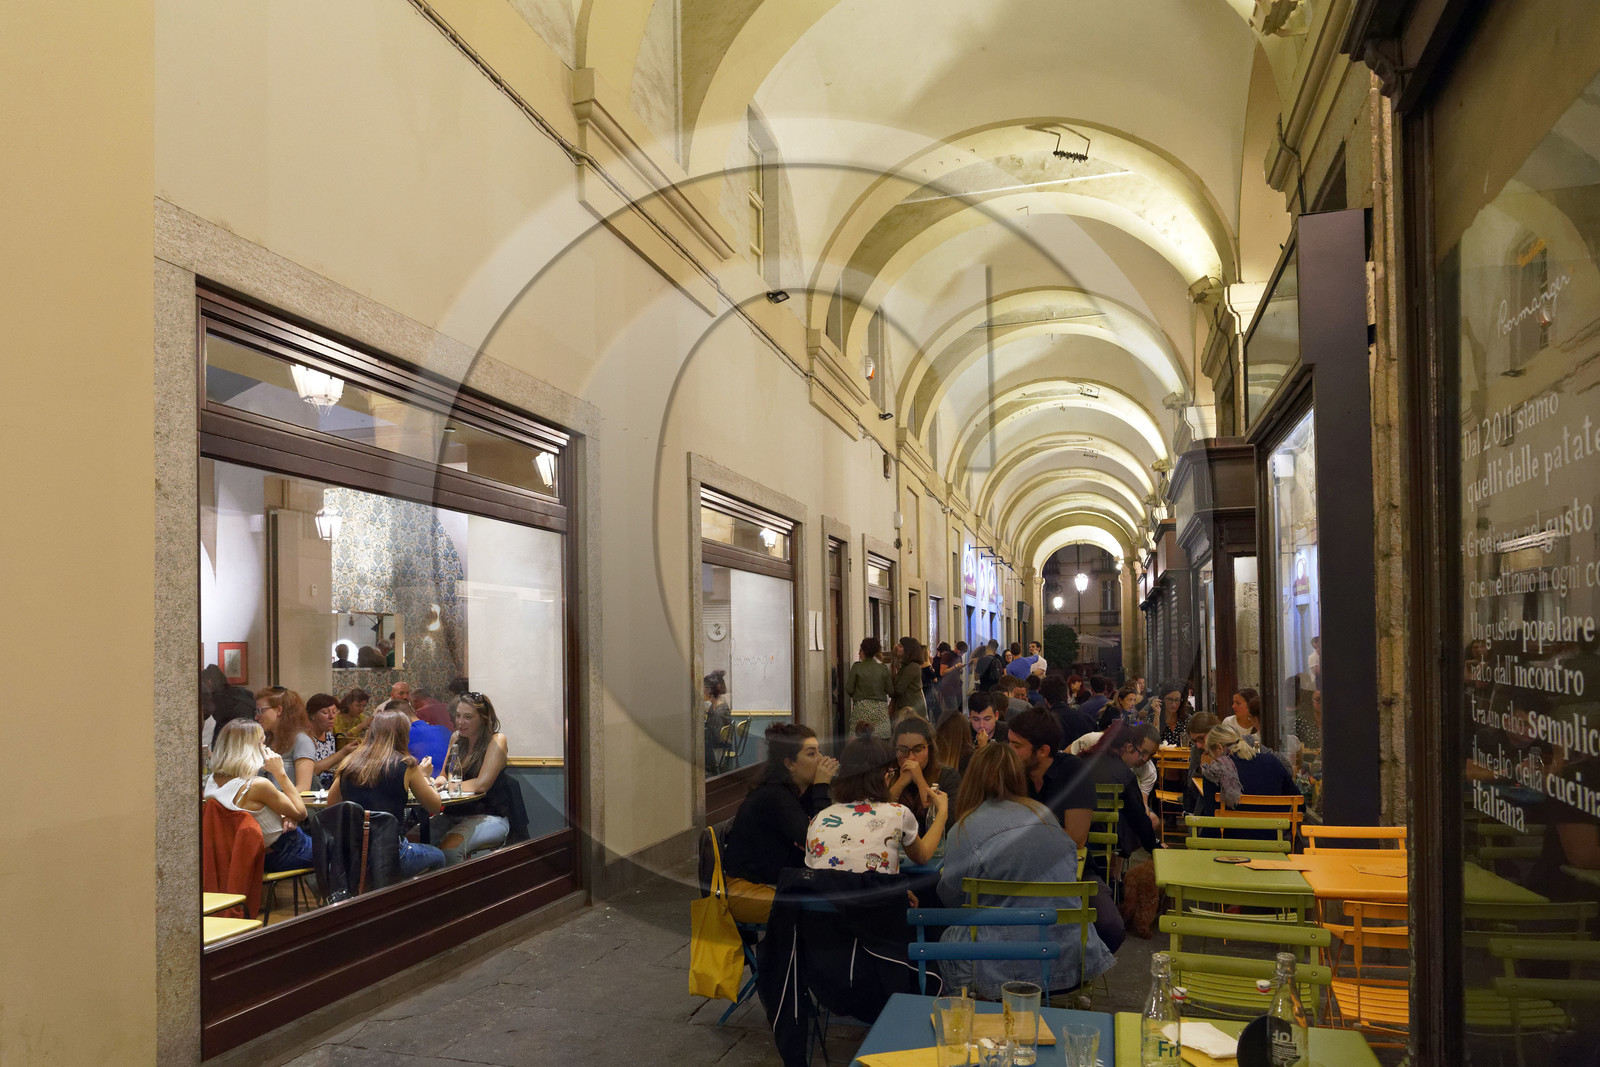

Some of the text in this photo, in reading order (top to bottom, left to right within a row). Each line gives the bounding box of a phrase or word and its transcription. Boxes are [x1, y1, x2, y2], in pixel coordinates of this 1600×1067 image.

[1498, 275, 1570, 339] Poormanger
[1464, 392, 1559, 461] Dal 2011 siamo
[1467, 416, 1600, 512] quelli delle patate
[1543, 497, 1593, 553] gusto
[1470, 570, 1486, 599] che
[1489, 566, 1536, 596] mettiamo
[1539, 567, 1548, 591] in
[1552, 556, 1580, 598] ogni
[1471, 607, 1595, 654] Un gusto popolare
[1471, 654, 1584, 696] nato dall'incontro
[1471, 694, 1600, 760] tra un cibo semplic
[1478, 743, 1512, 779] meglio
[1515, 750, 1543, 792] della
